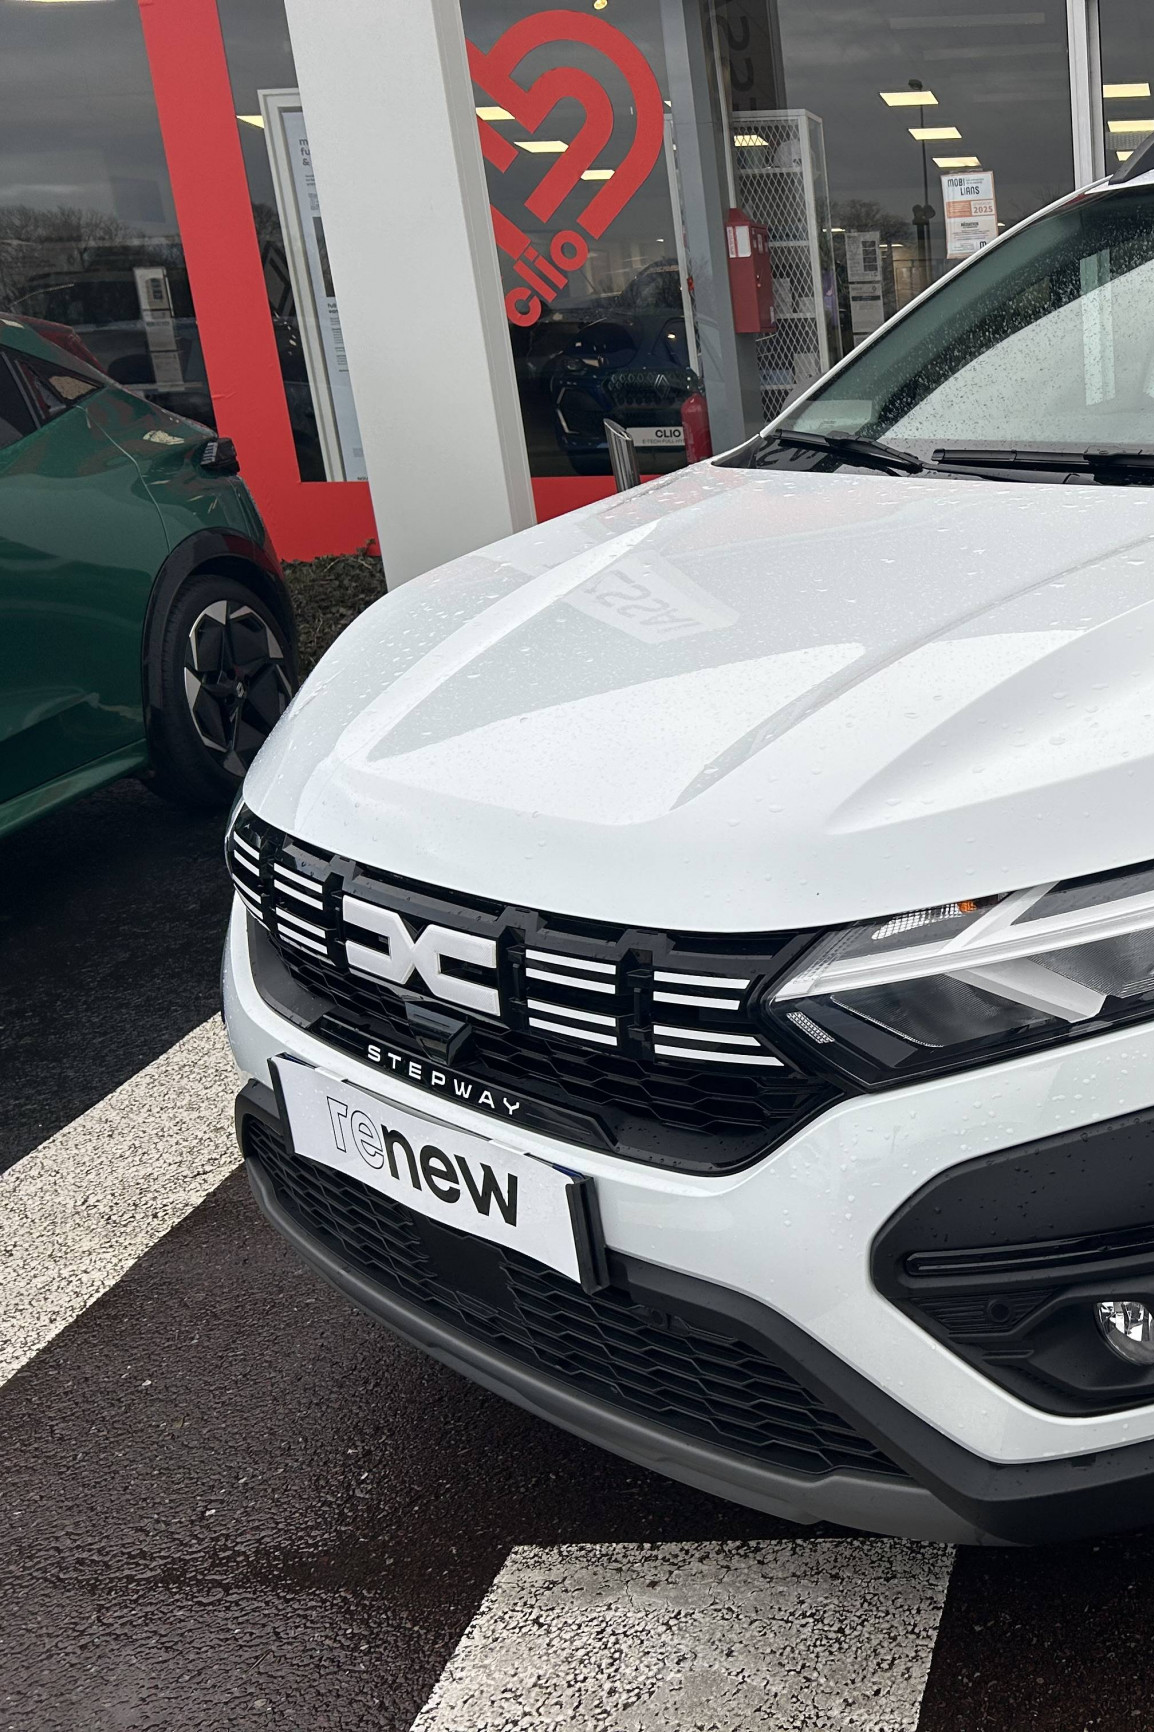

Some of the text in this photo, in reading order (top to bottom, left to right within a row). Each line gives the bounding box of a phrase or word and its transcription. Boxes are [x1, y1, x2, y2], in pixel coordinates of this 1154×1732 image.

[505, 229, 589, 327] clio
[655, 429, 681, 438] CLIO
[367, 1043, 520, 1115] STEPWAY
[326, 1095, 519, 1228] renew
